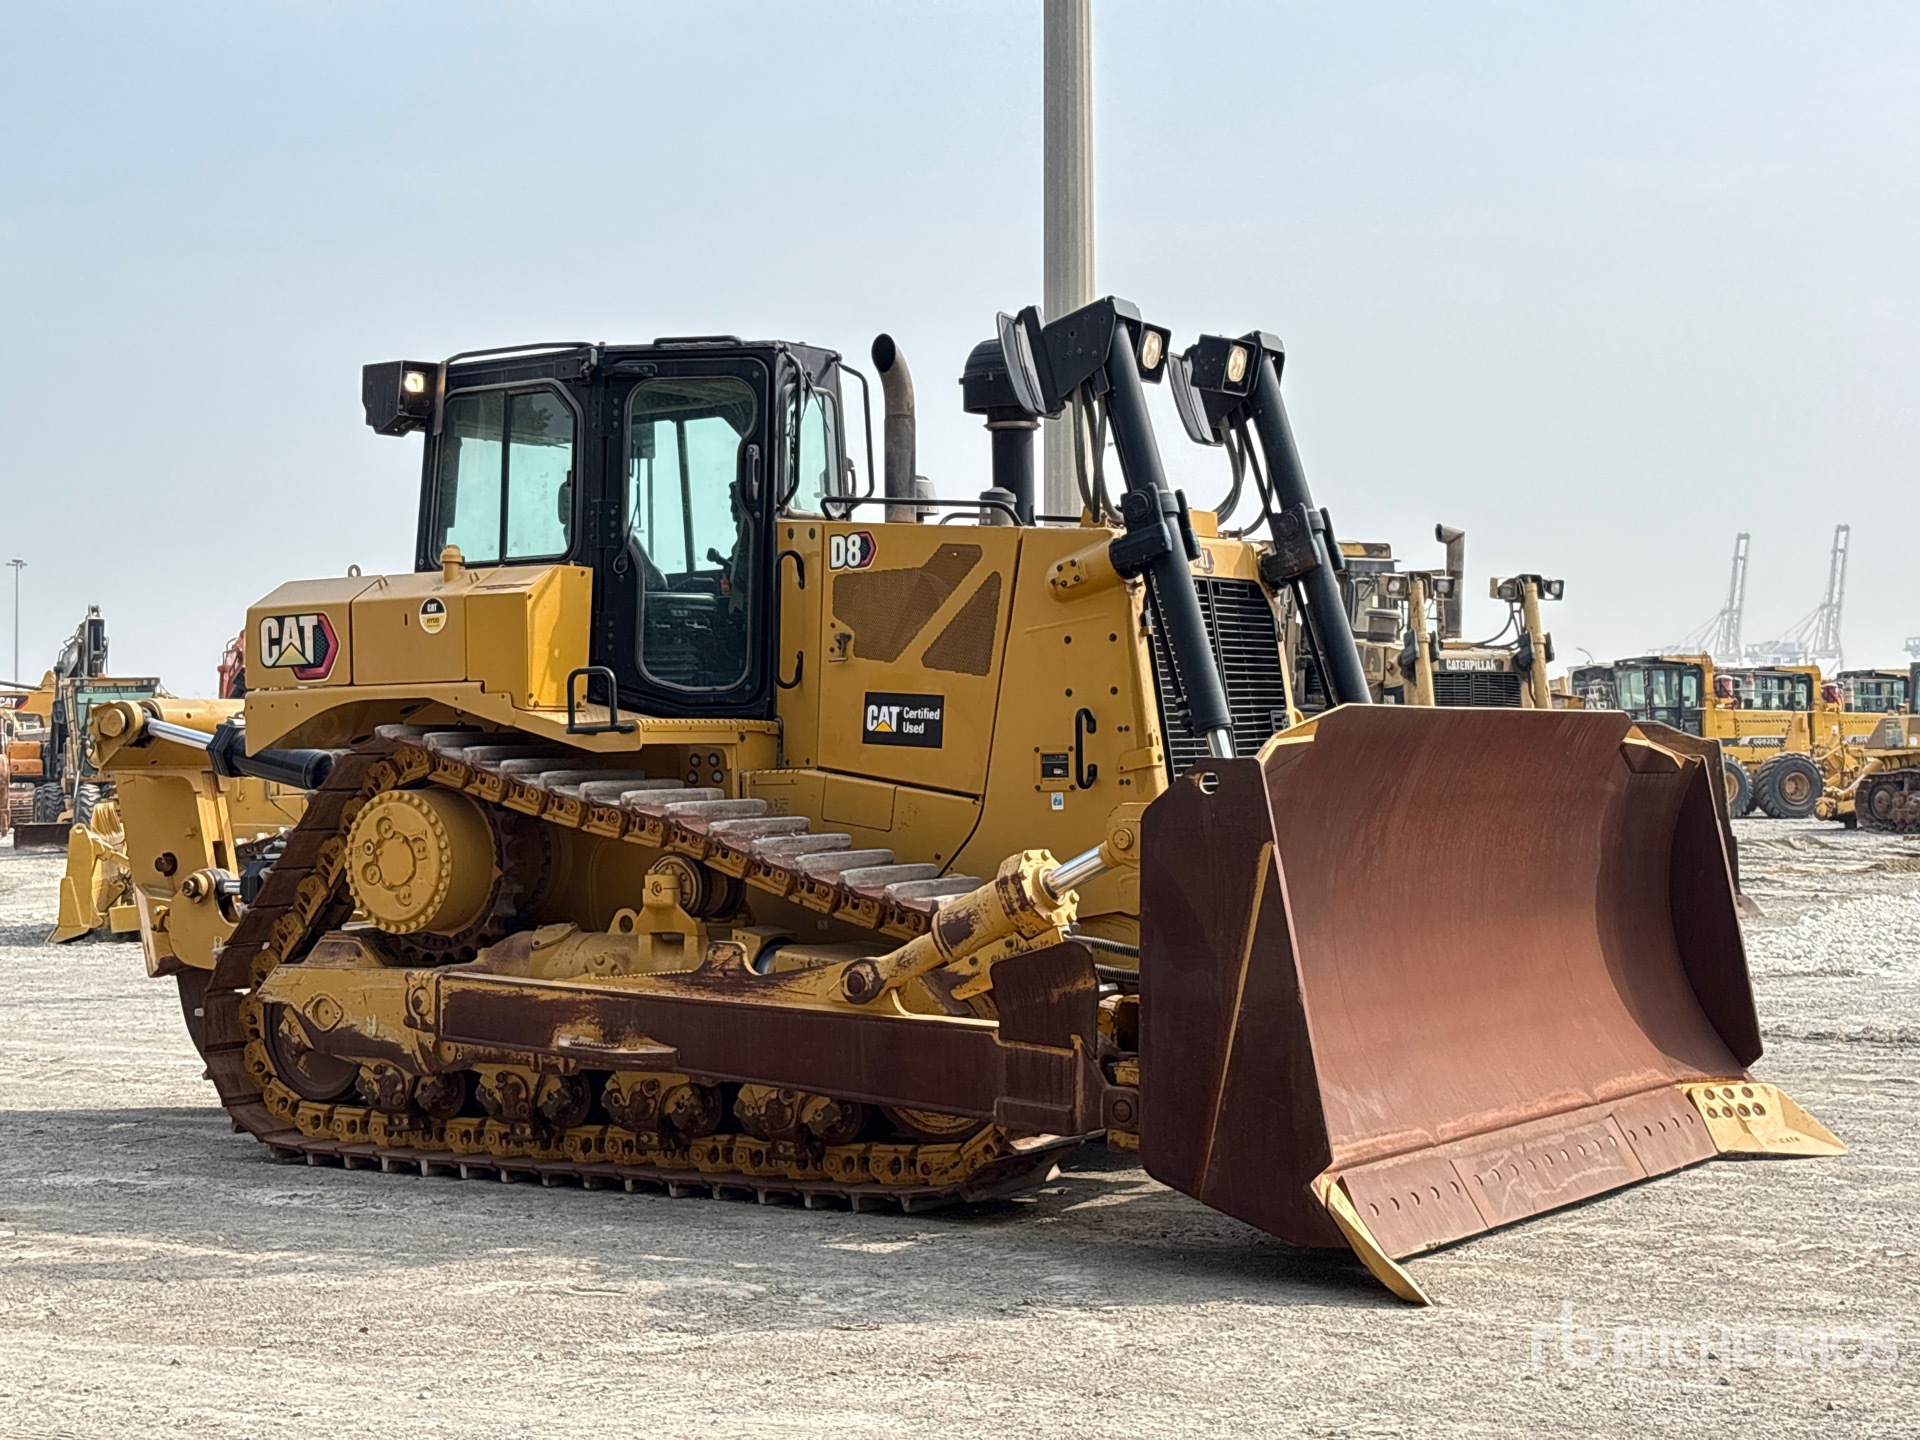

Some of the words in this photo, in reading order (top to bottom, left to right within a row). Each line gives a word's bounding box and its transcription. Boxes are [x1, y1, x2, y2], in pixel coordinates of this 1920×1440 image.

[830, 533, 861, 568] D8
[427, 603, 438, 612] CAT
[260, 615, 318, 667] CAT
[1446, 659, 1496, 671] CATERPILLAR
[0, 696, 18, 709] CAT
[866, 704, 900, 733] CAT
[903, 706, 940, 720] Certified
[902, 721, 925, 734] Used
